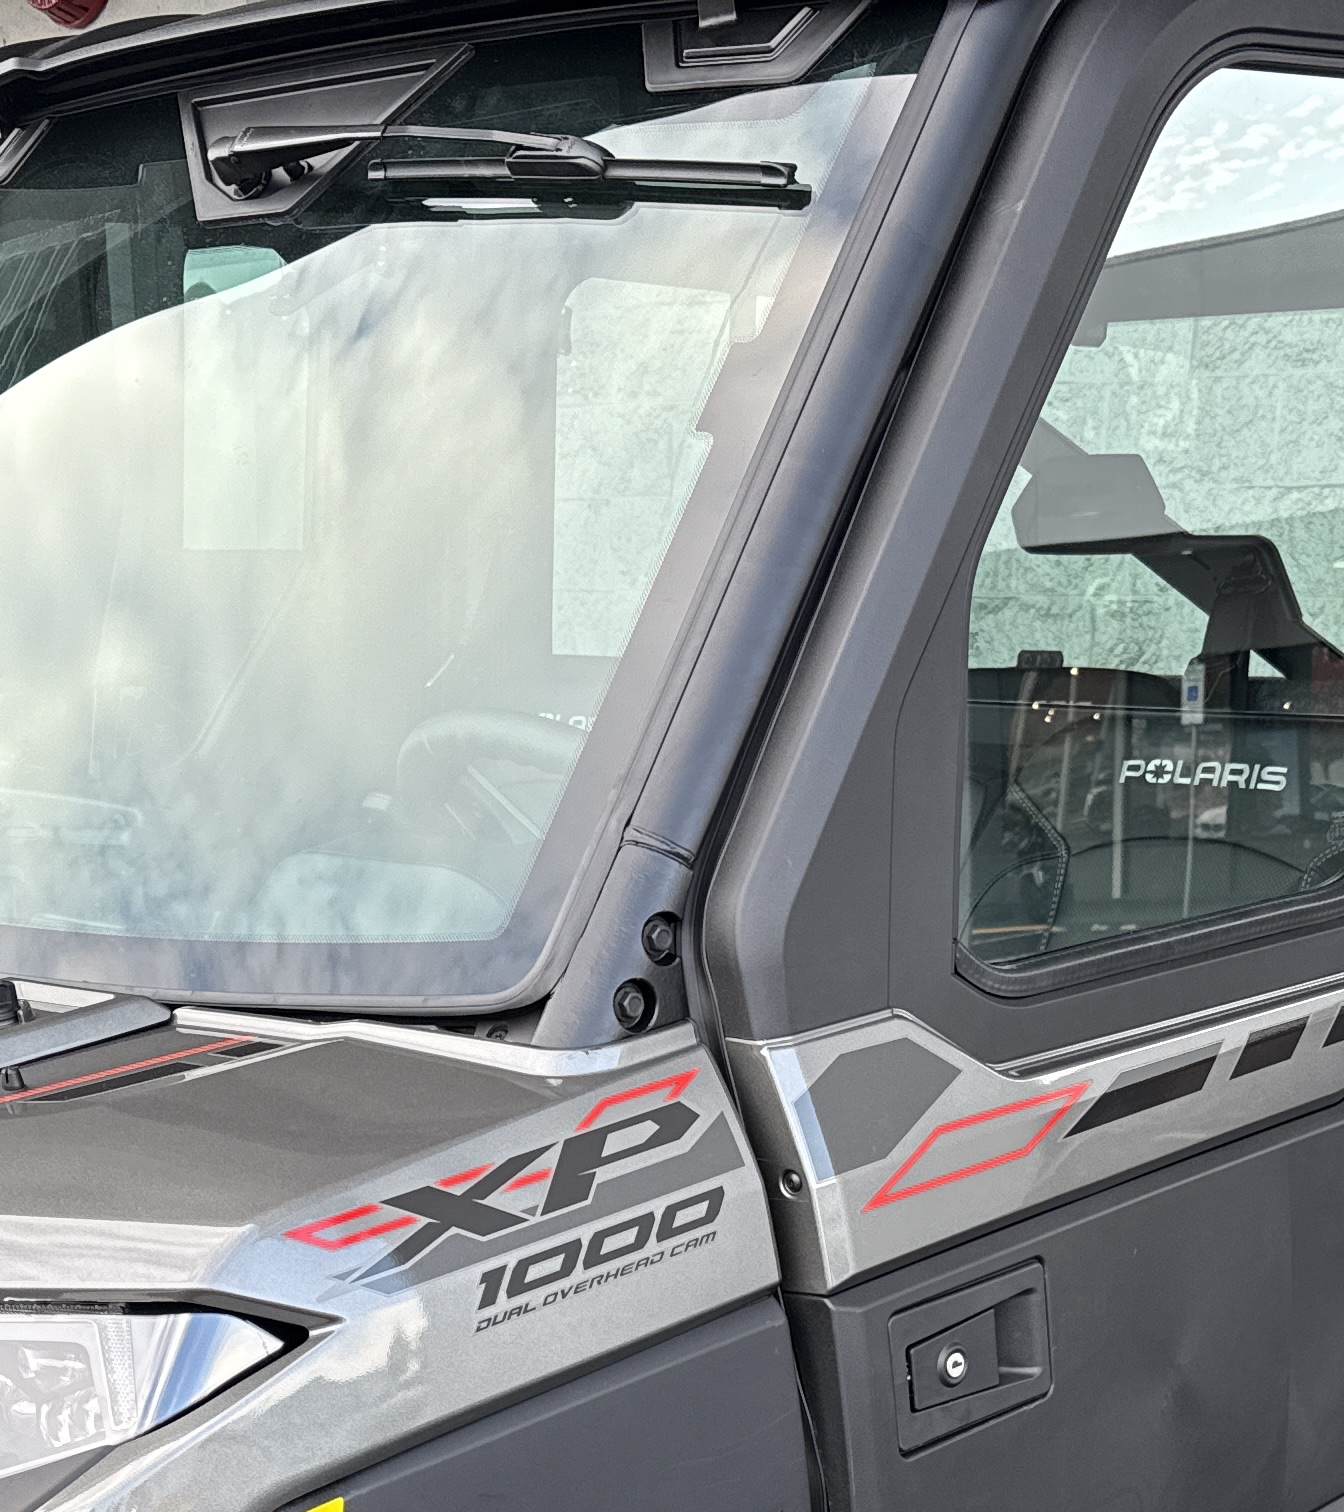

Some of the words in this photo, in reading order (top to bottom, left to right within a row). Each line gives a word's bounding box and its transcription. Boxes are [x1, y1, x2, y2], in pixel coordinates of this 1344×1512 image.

[1119, 758, 1288, 792] POLARIS
[349, 1100, 701, 1284] XP
[475, 1185, 725, 1311] 1000
[474, 1302, 537, 1333] DUAL
[542, 1250, 665, 1305] OVERHEAD
[669, 1230, 717, 1259] CAM
